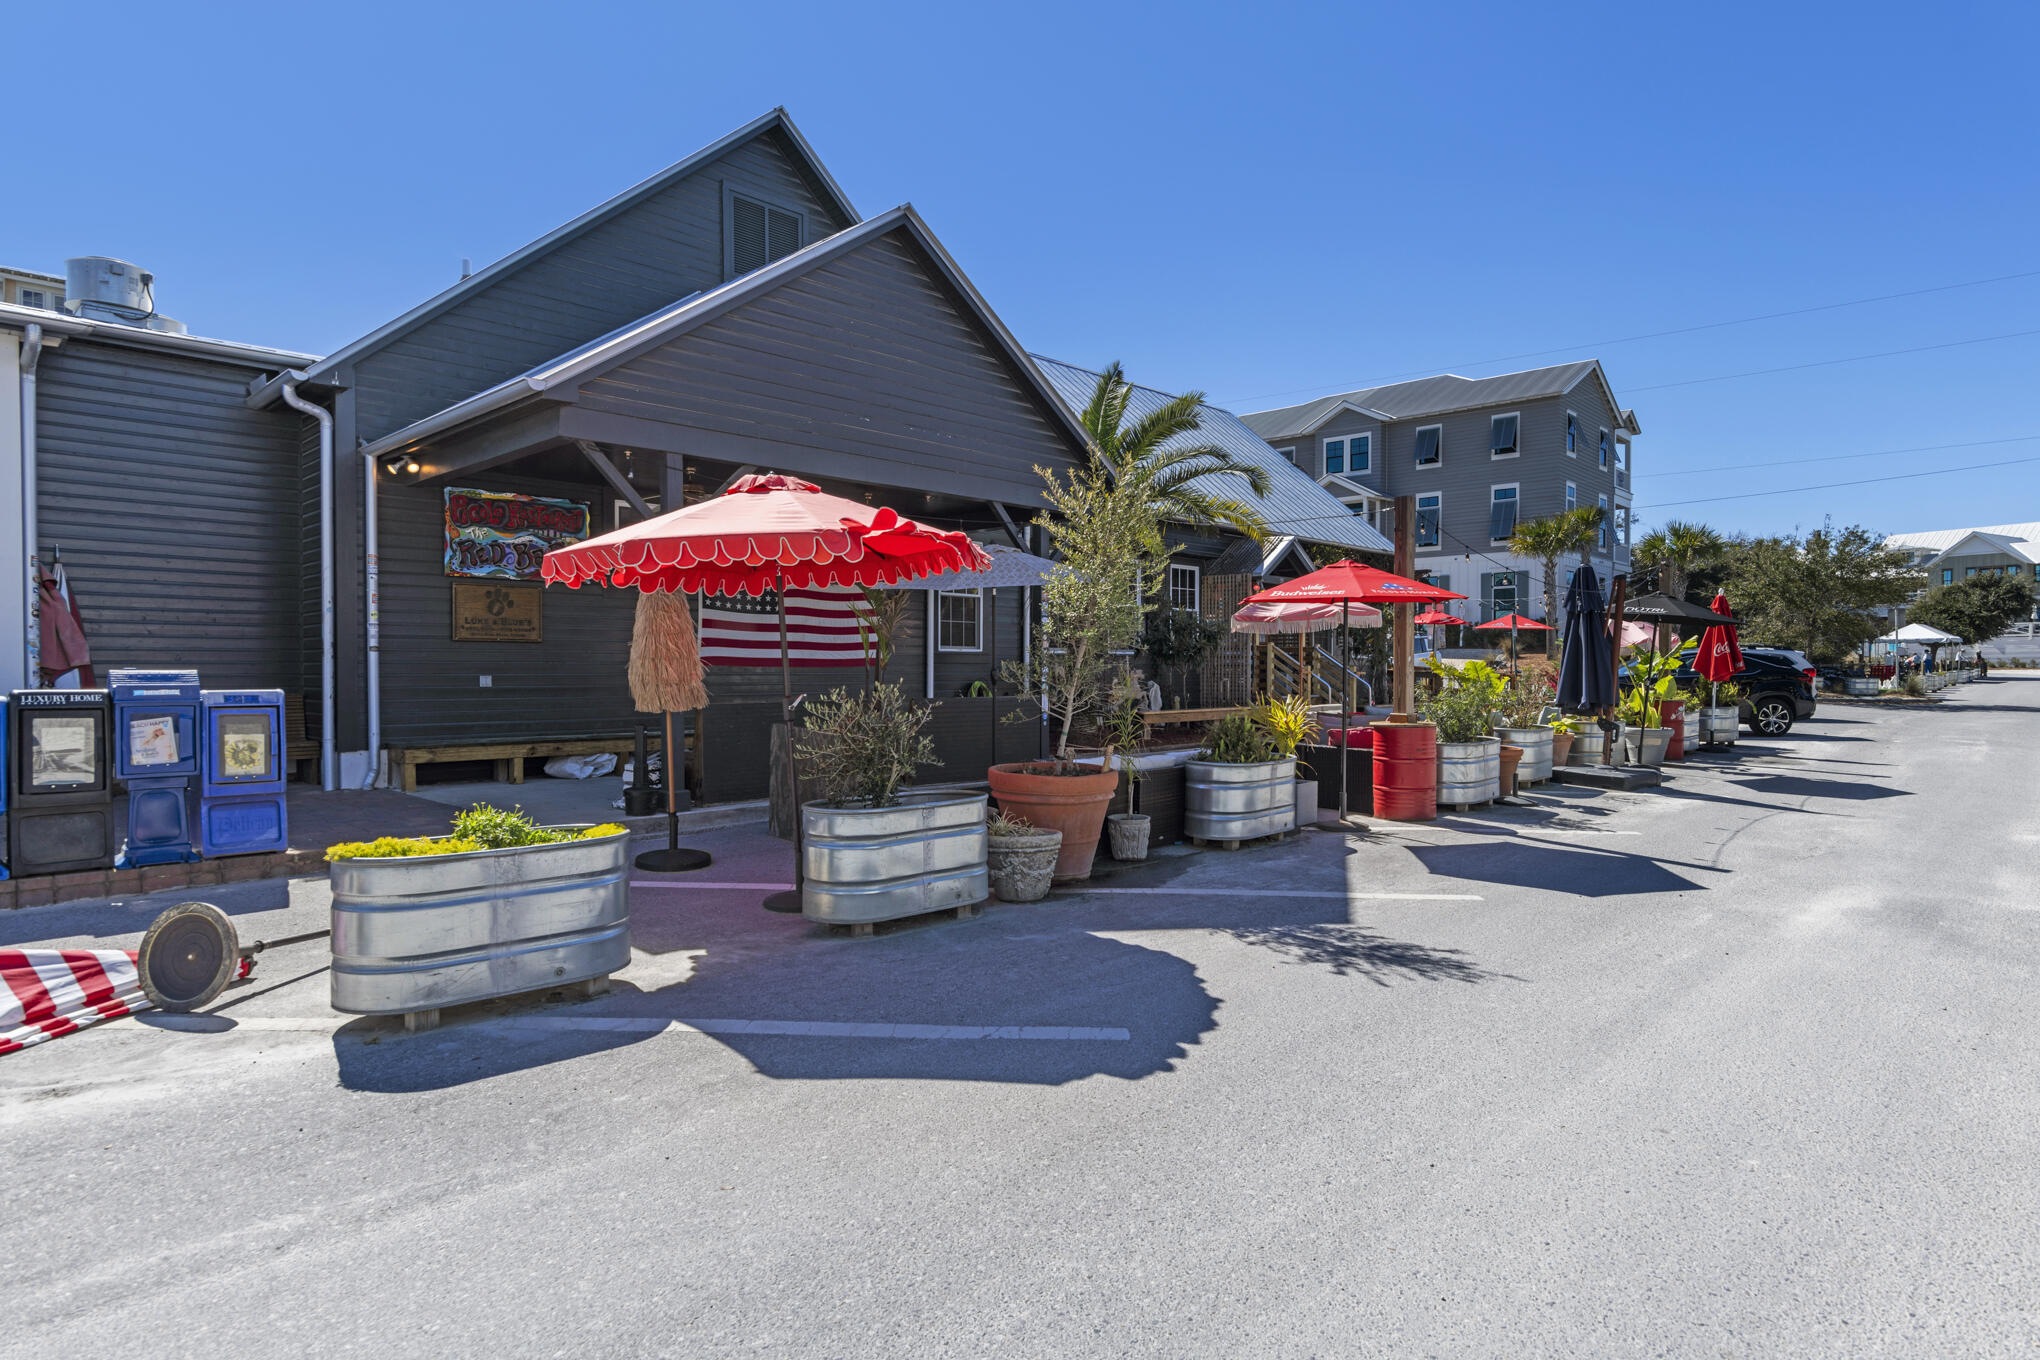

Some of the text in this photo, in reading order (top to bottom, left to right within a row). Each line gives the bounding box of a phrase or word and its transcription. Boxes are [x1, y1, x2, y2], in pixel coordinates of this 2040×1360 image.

[464, 527, 489, 540] The
[1269, 589, 1346, 597] Budweiser
[20, 694, 67, 703] LUXURY
[70, 693, 103, 702] HOME
